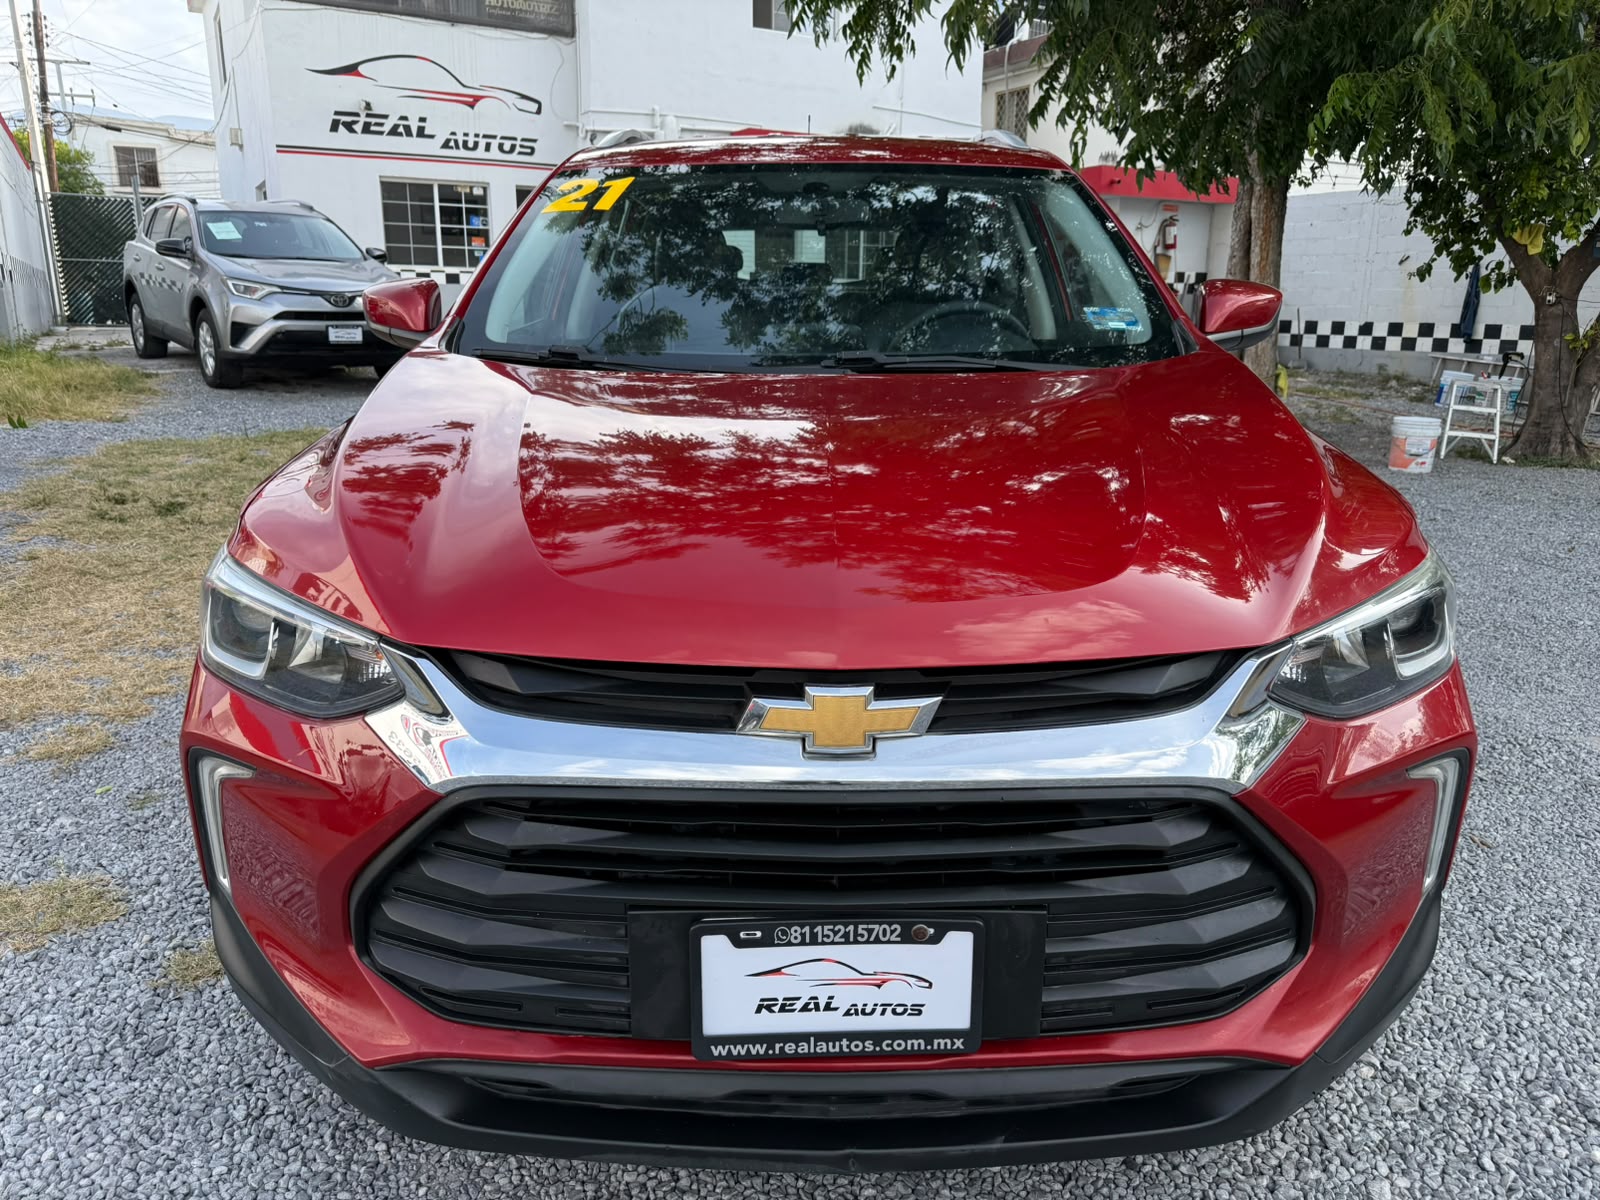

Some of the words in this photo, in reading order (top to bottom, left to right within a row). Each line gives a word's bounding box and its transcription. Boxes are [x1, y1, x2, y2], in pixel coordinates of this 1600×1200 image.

[329, 110, 436, 139] REAL
[440, 131, 538, 156] AUTOS
[540, 176, 635, 214] 21
[790, 924, 902, 943] 8115215702
[754, 995, 840, 1014] REAL
[842, 1003, 926, 1017] AUTOS
[710, 1036, 965, 1057] www.realautos.com.mx
